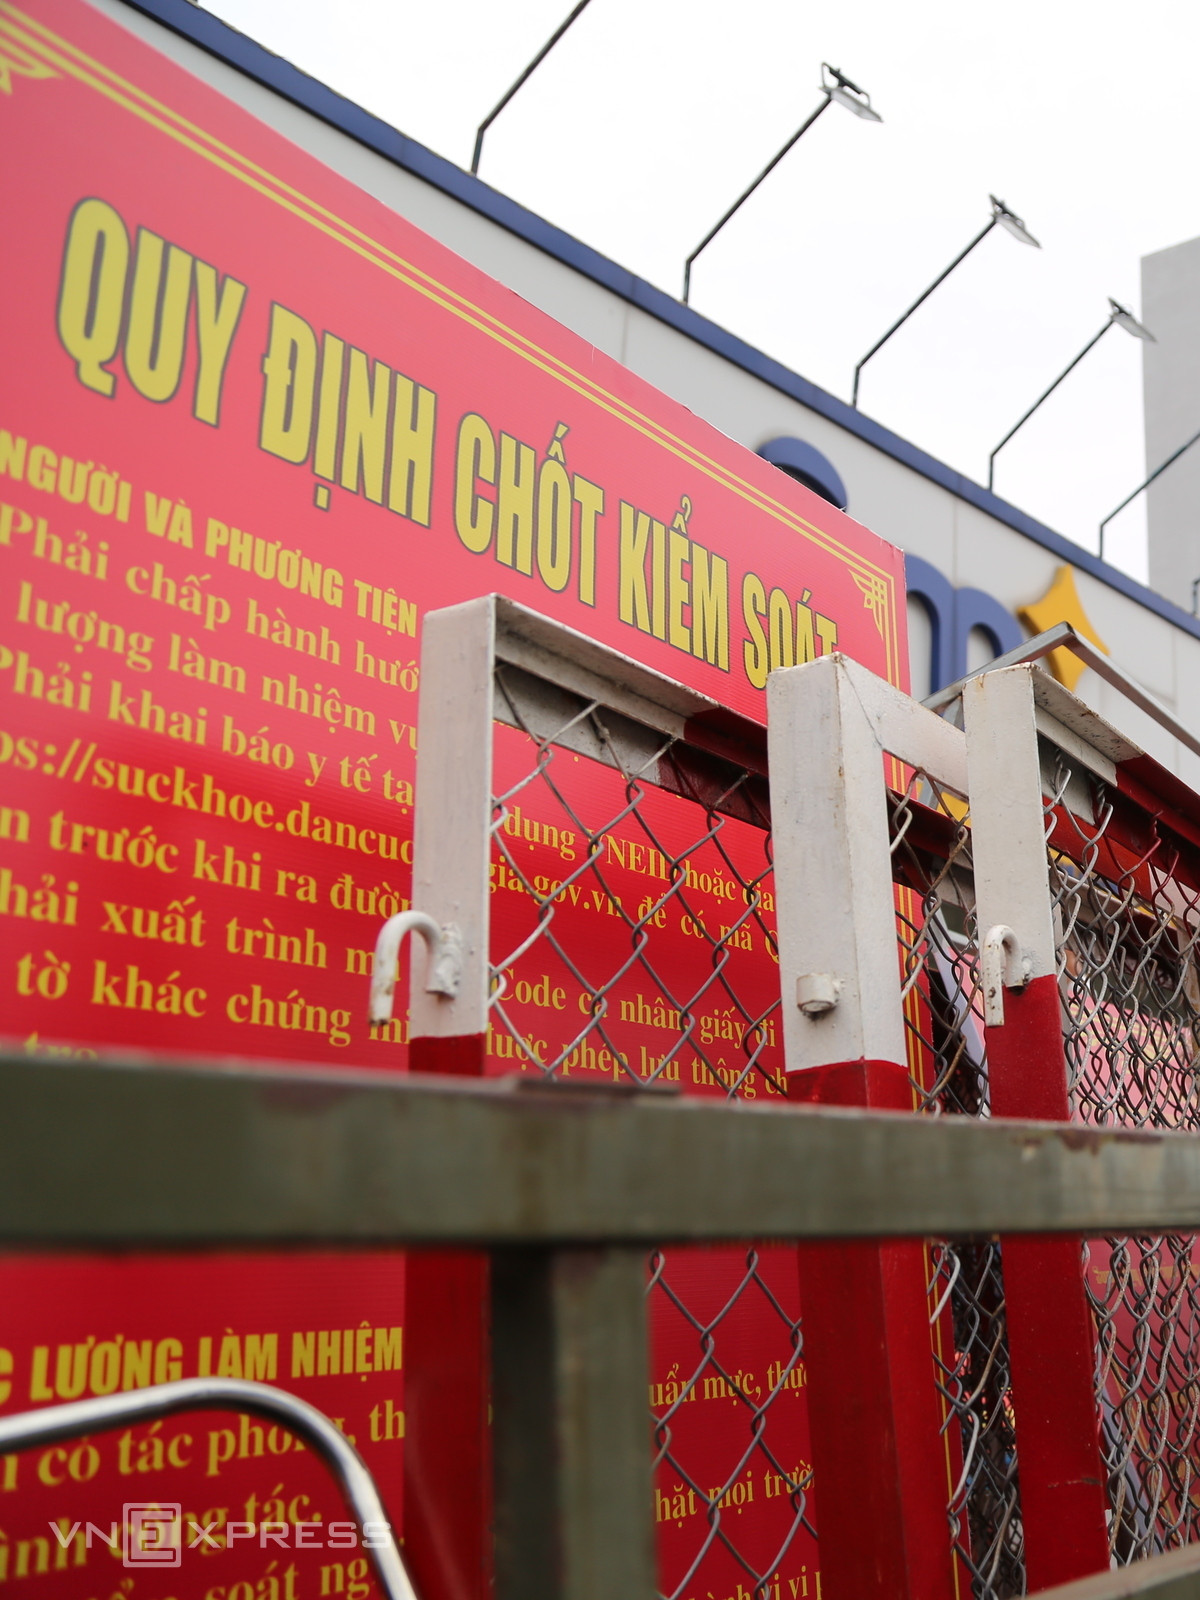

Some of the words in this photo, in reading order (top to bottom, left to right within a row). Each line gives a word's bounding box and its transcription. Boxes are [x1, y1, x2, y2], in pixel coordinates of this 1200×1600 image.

[56, 197, 248, 428] QUY
[258, 301, 437, 529] ĐỊNH
[454, 411, 604, 608] CHỐT
[619, 495, 730, 673] KIỂM
[742, 572, 838, 689] SOÁT
[0, 428, 132, 523] NGƯỜI
[145, 489, 194, 549] VÀ
[205, 517, 343, 608] PHƯƠNG
[353, 579, 417, 637] TIỆN
[0, 503, 110, 581] Phải
[125, 562, 231, 632] chấp
[246, 598, 341, 666] hành
[16, 581, 155, 673] lượng
[168, 633, 247, 694] làm
[261, 675, 377, 736] nhiệm
[50, 810, 179, 873] trước
[192, 839, 262, 892] khi
[275, 869, 318, 905] ra
[108, 680, 208, 746] khai
[222, 715, 295, 771] báo
[305, 752, 327, 786] y
[340, 754, 378, 793] tế
[503, 805, 576, 860] dụng
[685, 860, 737, 904] hoặc
[101, 896, 207, 948] xuất
[226, 917, 328, 969] trình
[490, 967, 567, 1011] Code
[700, 1006, 746, 1049] giấy
[638, 892, 667, 928] để
[681, 910, 706, 939] có
[720, 922, 753, 951] mã
[16, 950, 71, 1000] tờ
[91, 960, 208, 1018] khác
[226, 984, 352, 1048] chứng
[561, 1037, 630, 1083] phép
[640, 1046, 681, 1081] lưu
[691, 1057, 757, 1099] thông
[118, 1420, 193, 1476] tác
[703, 1370, 762, 1406] mực,
[199, 1327, 278, 1381] LÀM
[291, 1320, 403, 1382] NHIỆM
[243, 1483, 322, 1535] tác.
[708, 1471, 754, 1515] mọi
[764, 1459, 815, 1499] trườ
